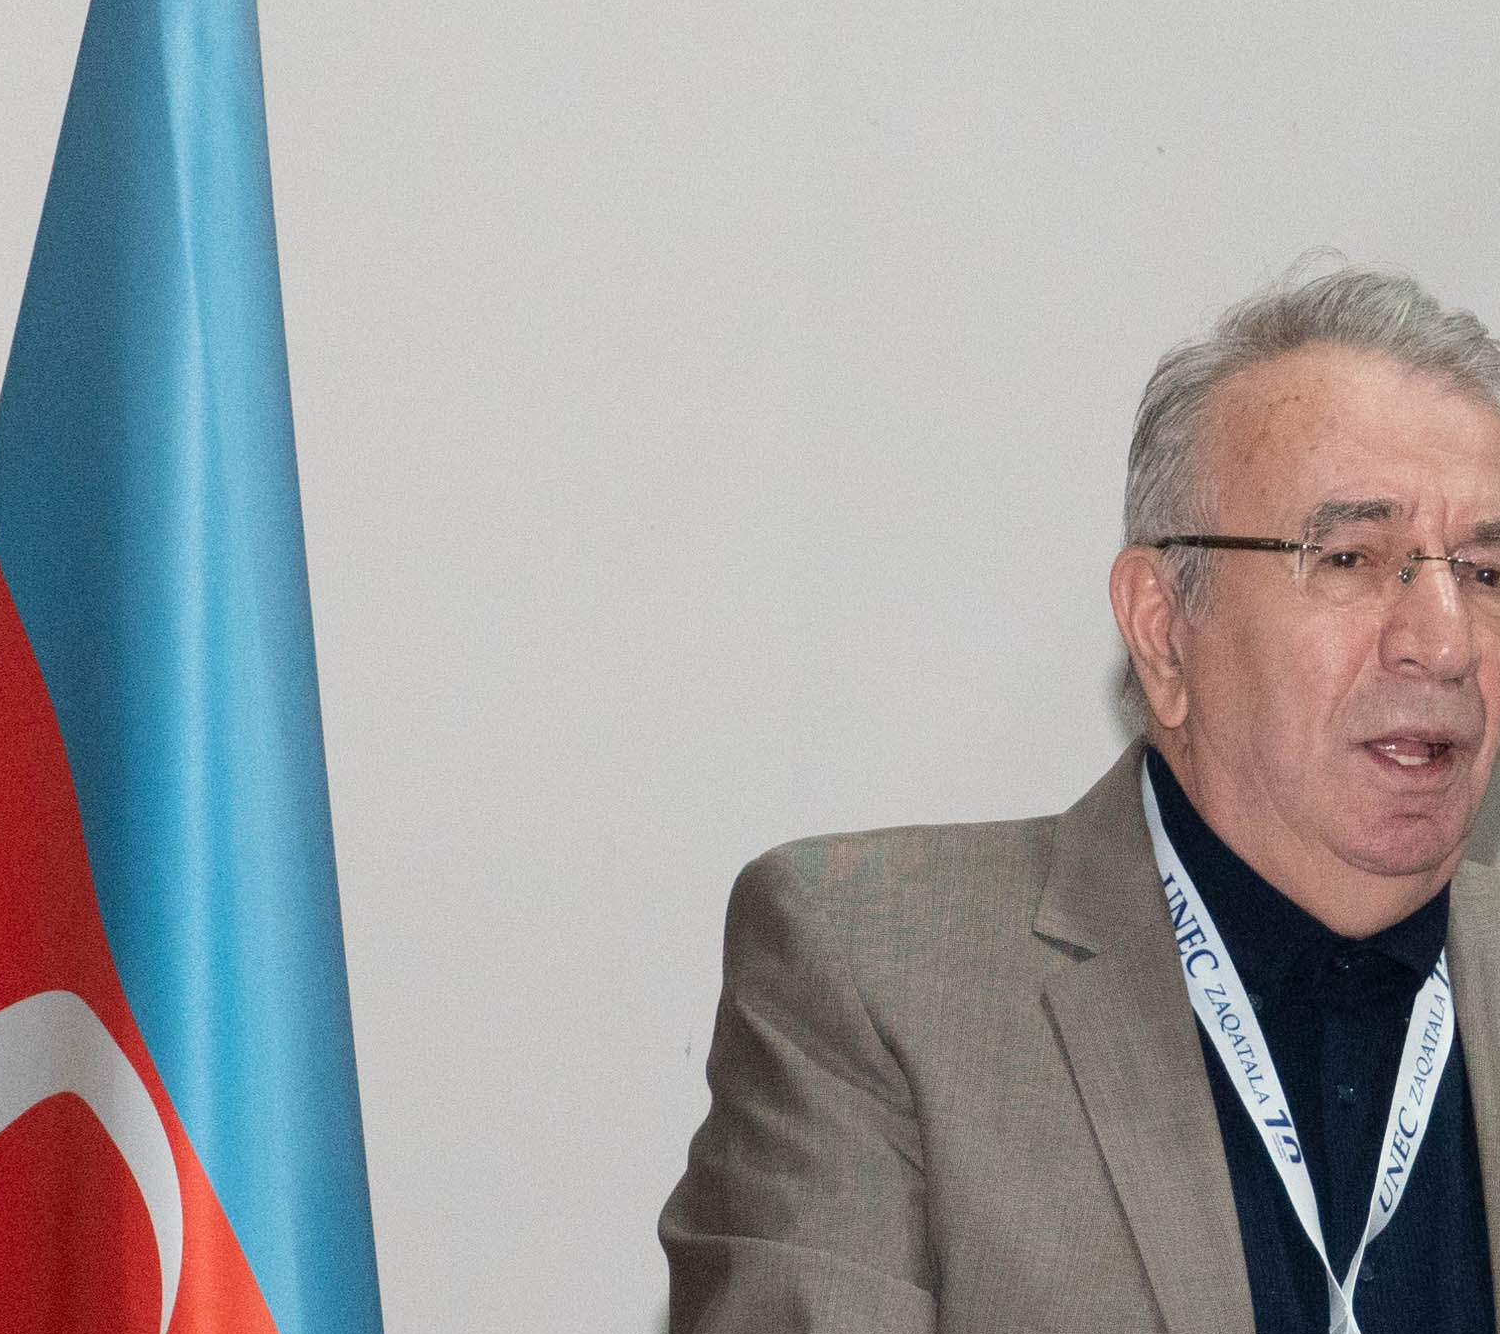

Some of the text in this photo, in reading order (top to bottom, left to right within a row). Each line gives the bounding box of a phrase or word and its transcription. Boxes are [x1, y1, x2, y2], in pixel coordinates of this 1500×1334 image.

[1204, 983, 1271, 1104] ZAQATALA
[1379, 1106, 1418, 1214] UNEC
[1408, 993, 1446, 1107] ZAQATALA
